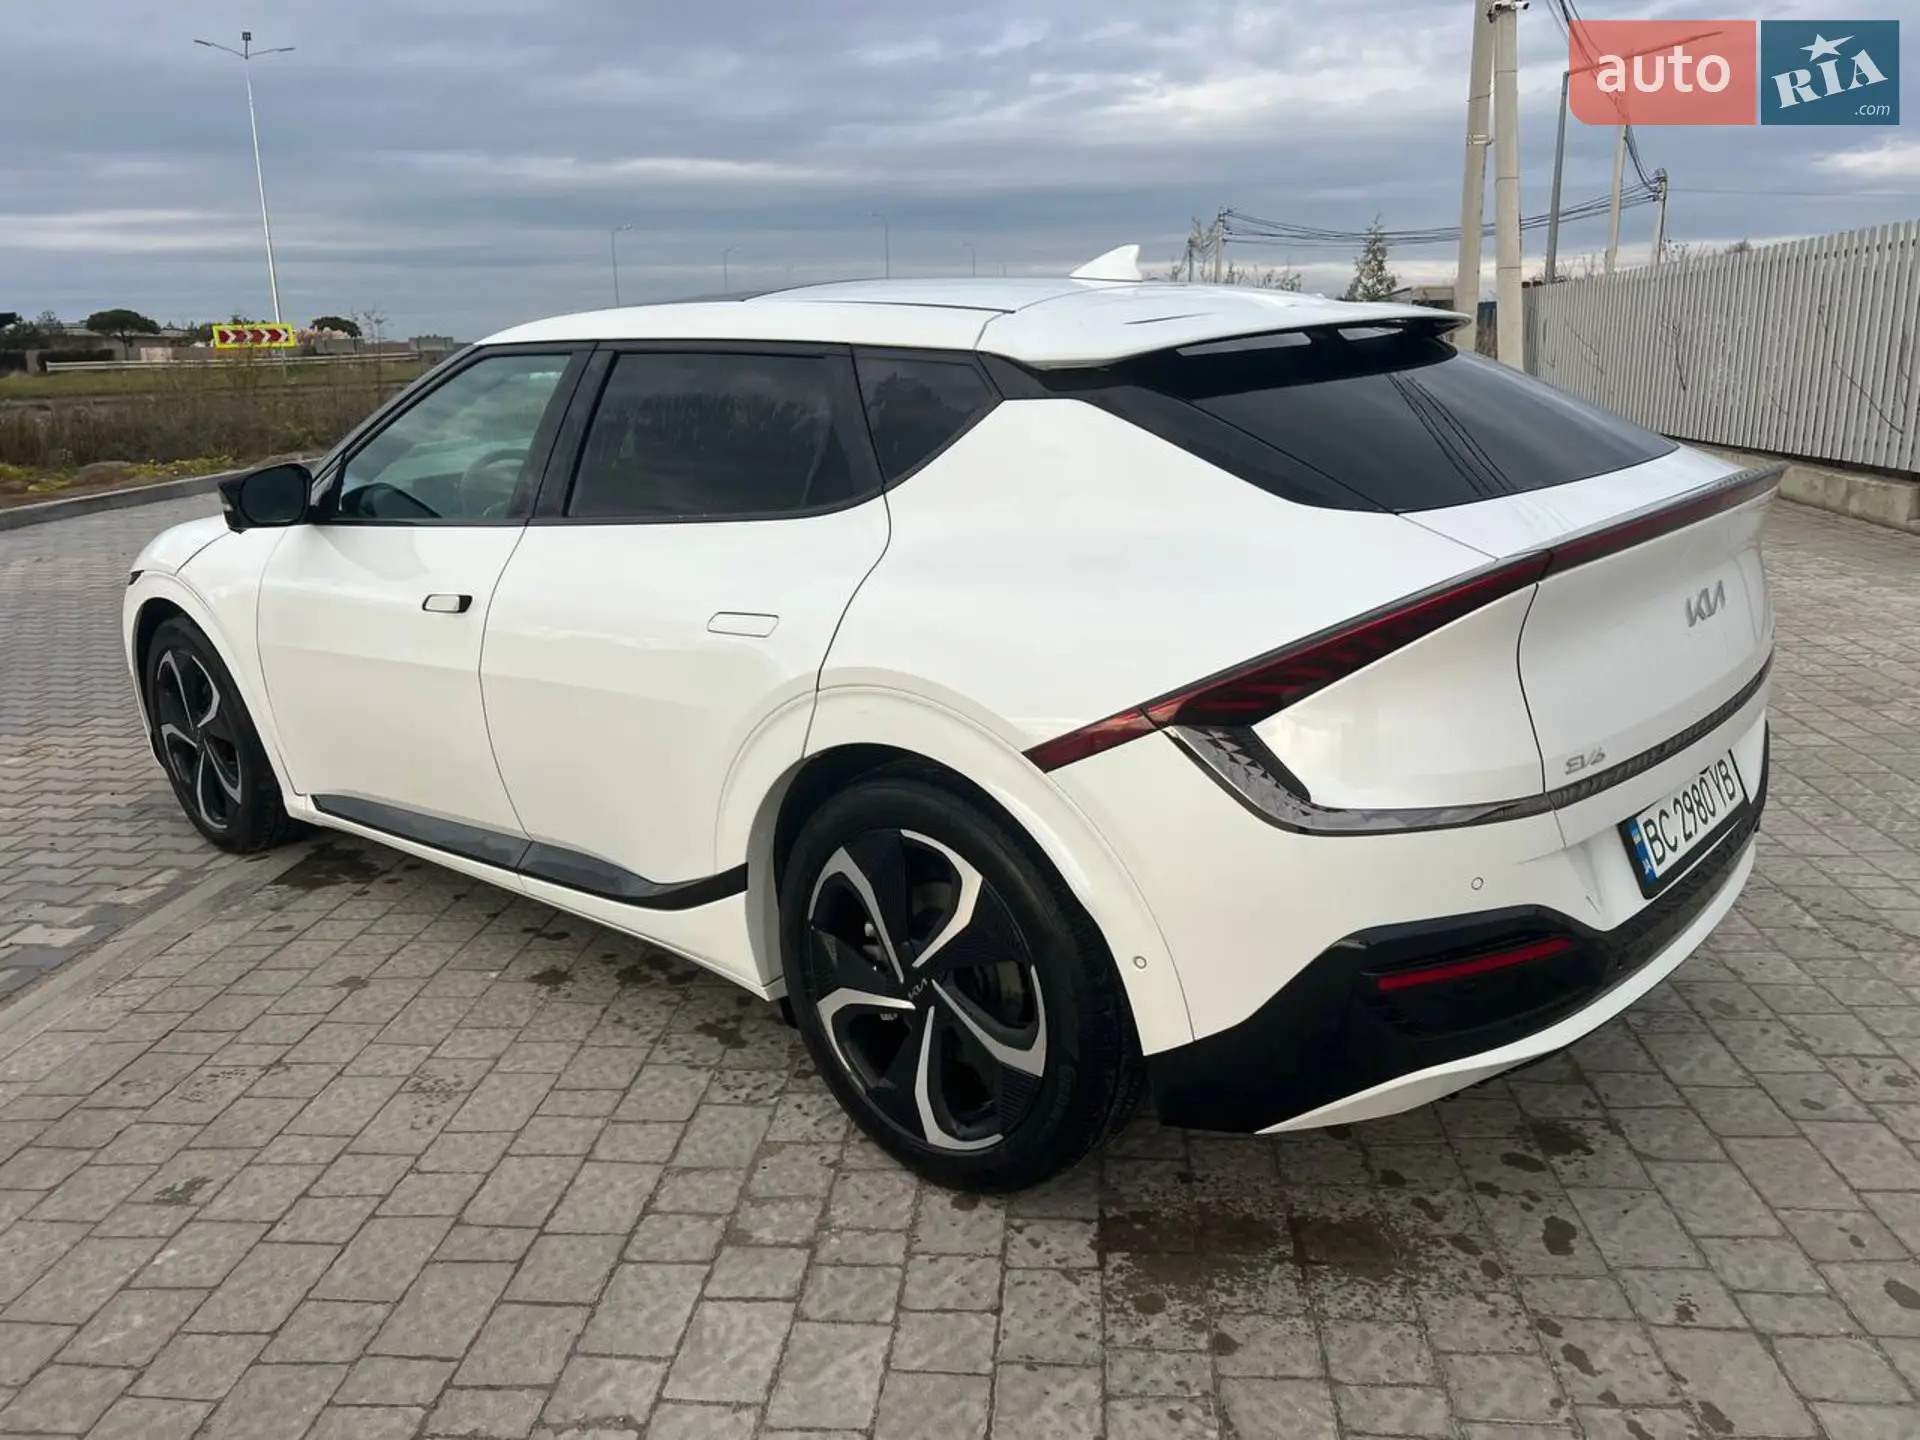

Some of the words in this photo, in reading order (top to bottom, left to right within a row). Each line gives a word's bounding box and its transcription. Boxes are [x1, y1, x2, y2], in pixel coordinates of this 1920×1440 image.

[1564, 747, 1606, 775] EV6
[1642, 818, 1678, 867] BC
[1673, 776, 1717, 843] 2980
[1708, 758, 1736, 809] YB
